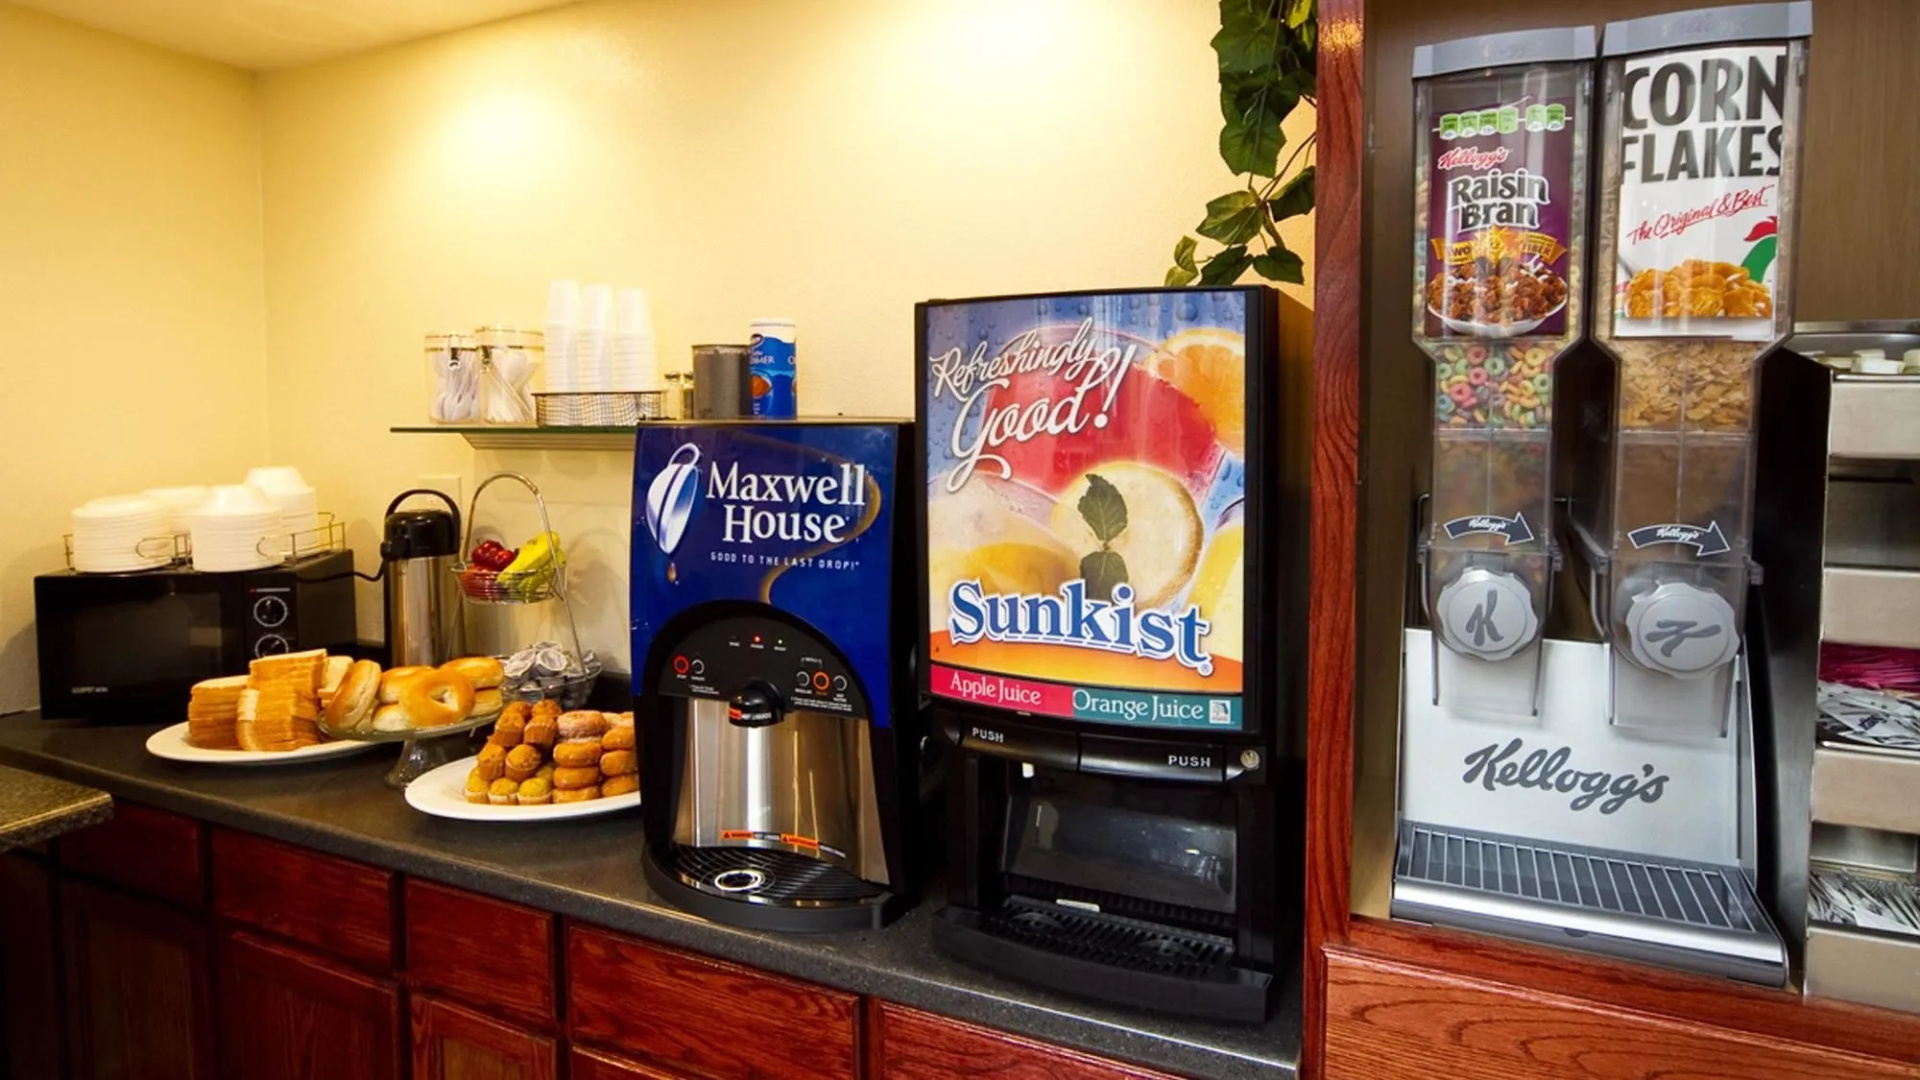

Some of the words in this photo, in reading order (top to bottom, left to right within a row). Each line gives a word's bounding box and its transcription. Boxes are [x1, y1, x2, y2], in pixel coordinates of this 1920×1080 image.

[1622, 55, 1786, 130] CORN
[1437, 146, 1510, 170] Kellogg's
[1621, 125, 1784, 185] FLAKES
[1448, 168, 1551, 205] Raisin
[1458, 200, 1540, 236] Bran
[1626, 220, 1651, 245] The
[1653, 198, 1717, 236] Original
[1731, 184, 1775, 216] Best
[929, 316, 1100, 402] Refreshingly
[945, 343, 1138, 494] Good!
[705, 460, 866, 506] Maxwell
[721, 503, 846, 544] House
[1468, 516, 1507, 532] Kellogg's
[1656, 526, 1700, 541] Kellogg's
[710, 551, 737, 563] GOOD
[742, 554, 755, 564] TO
[759, 555, 779, 566] THE
[784, 557, 814, 568] LAST
[949, 577, 1213, 671] Sunkist
[1465, 588, 1504, 647] K
[950, 670, 996, 700] Apple
[998, 678, 1042, 706] Juice
[1072, 689, 1148, 721] Orange
[1152, 694, 1204, 721] Juice
[972, 726, 1004, 743] PUSH
[1168, 754, 1211, 768] PUSH
[1462, 737, 1670, 815] Kellogg's
